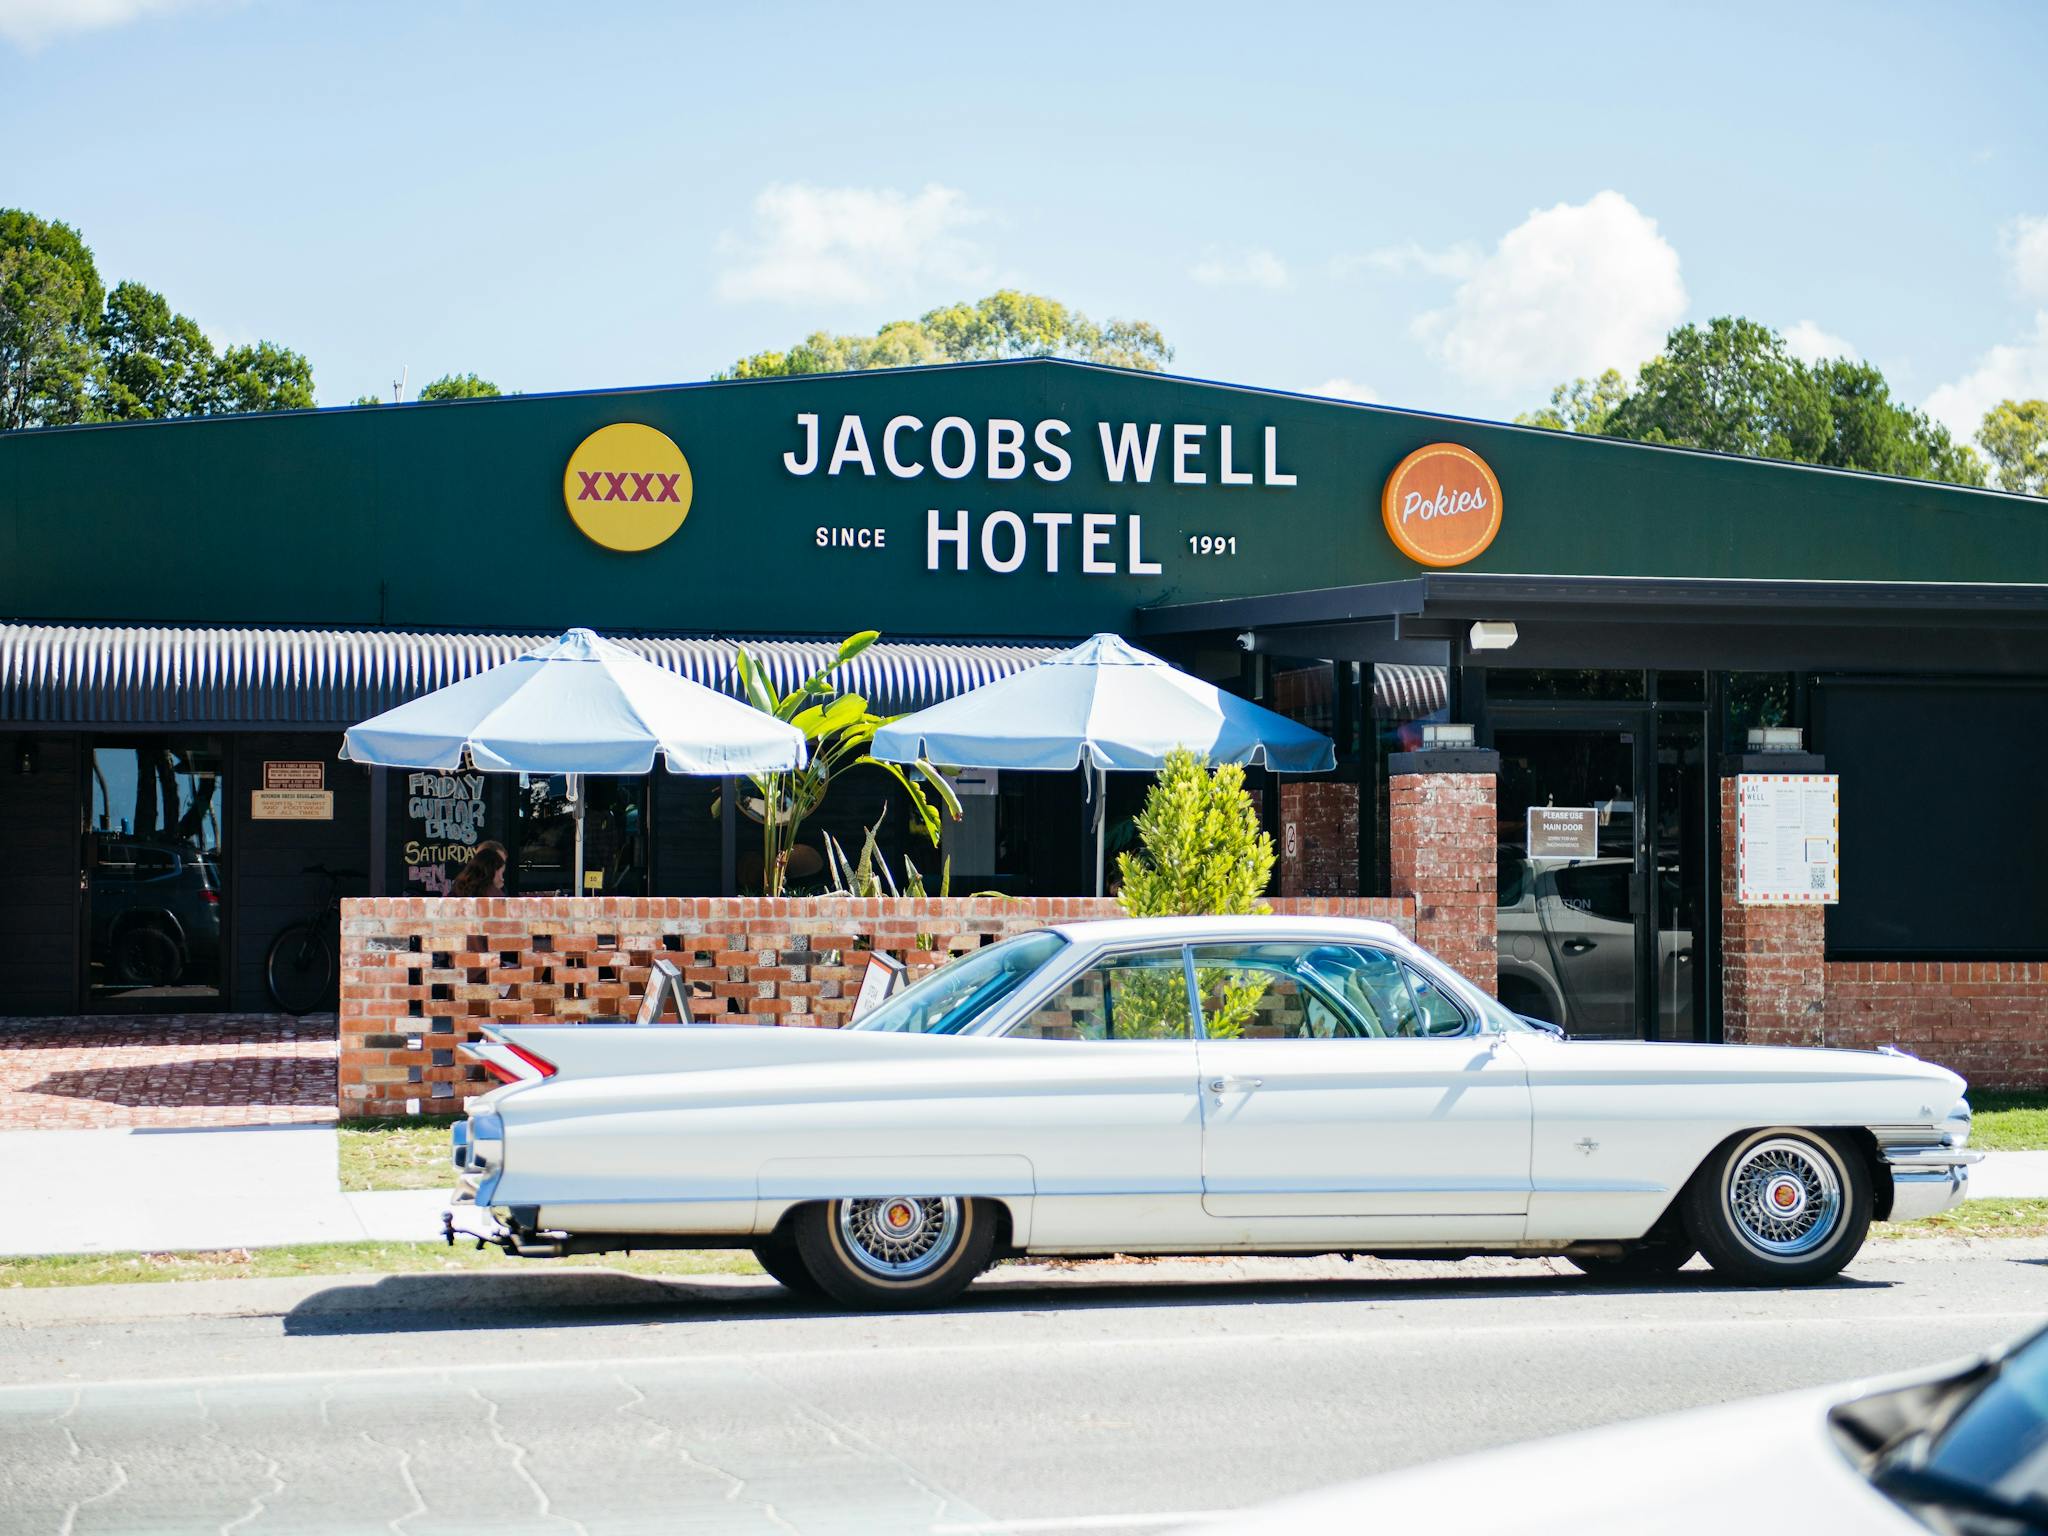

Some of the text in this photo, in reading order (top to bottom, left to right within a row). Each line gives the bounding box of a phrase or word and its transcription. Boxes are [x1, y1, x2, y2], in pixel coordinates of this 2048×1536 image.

[783, 413, 1297, 485] JACOBS WELL
[577, 471, 681, 502] XXXX
[1402, 485, 1487, 524] Pokies
[815, 527, 886, 548] SINCE
[927, 509, 1162, 574] HOTEL
[1189, 535, 1237, 555] 1991
[408, 772, 485, 800] FRIDAY
[1746, 793, 1765, 801] WELL
[408, 797, 486, 827] GUITAR
[1543, 811, 1584, 820] PLEASE USE
[1543, 823, 1584, 831] MAIN DOOR
